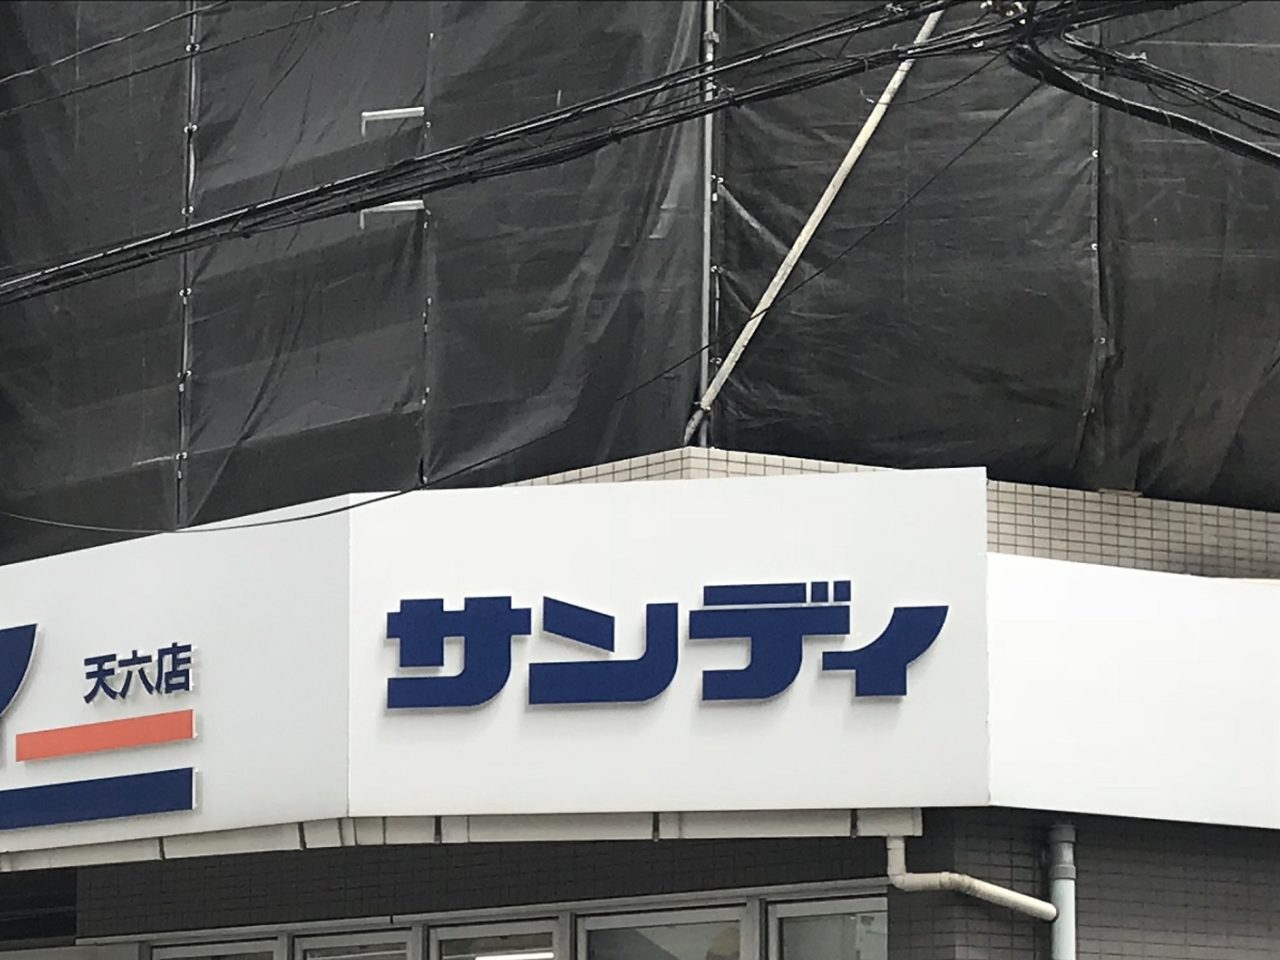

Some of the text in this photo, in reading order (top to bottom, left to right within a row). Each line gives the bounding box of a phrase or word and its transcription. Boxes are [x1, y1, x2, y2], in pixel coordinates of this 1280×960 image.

[83, 642, 192, 703] 天六店
[387, 580, 949, 709] サンディ
